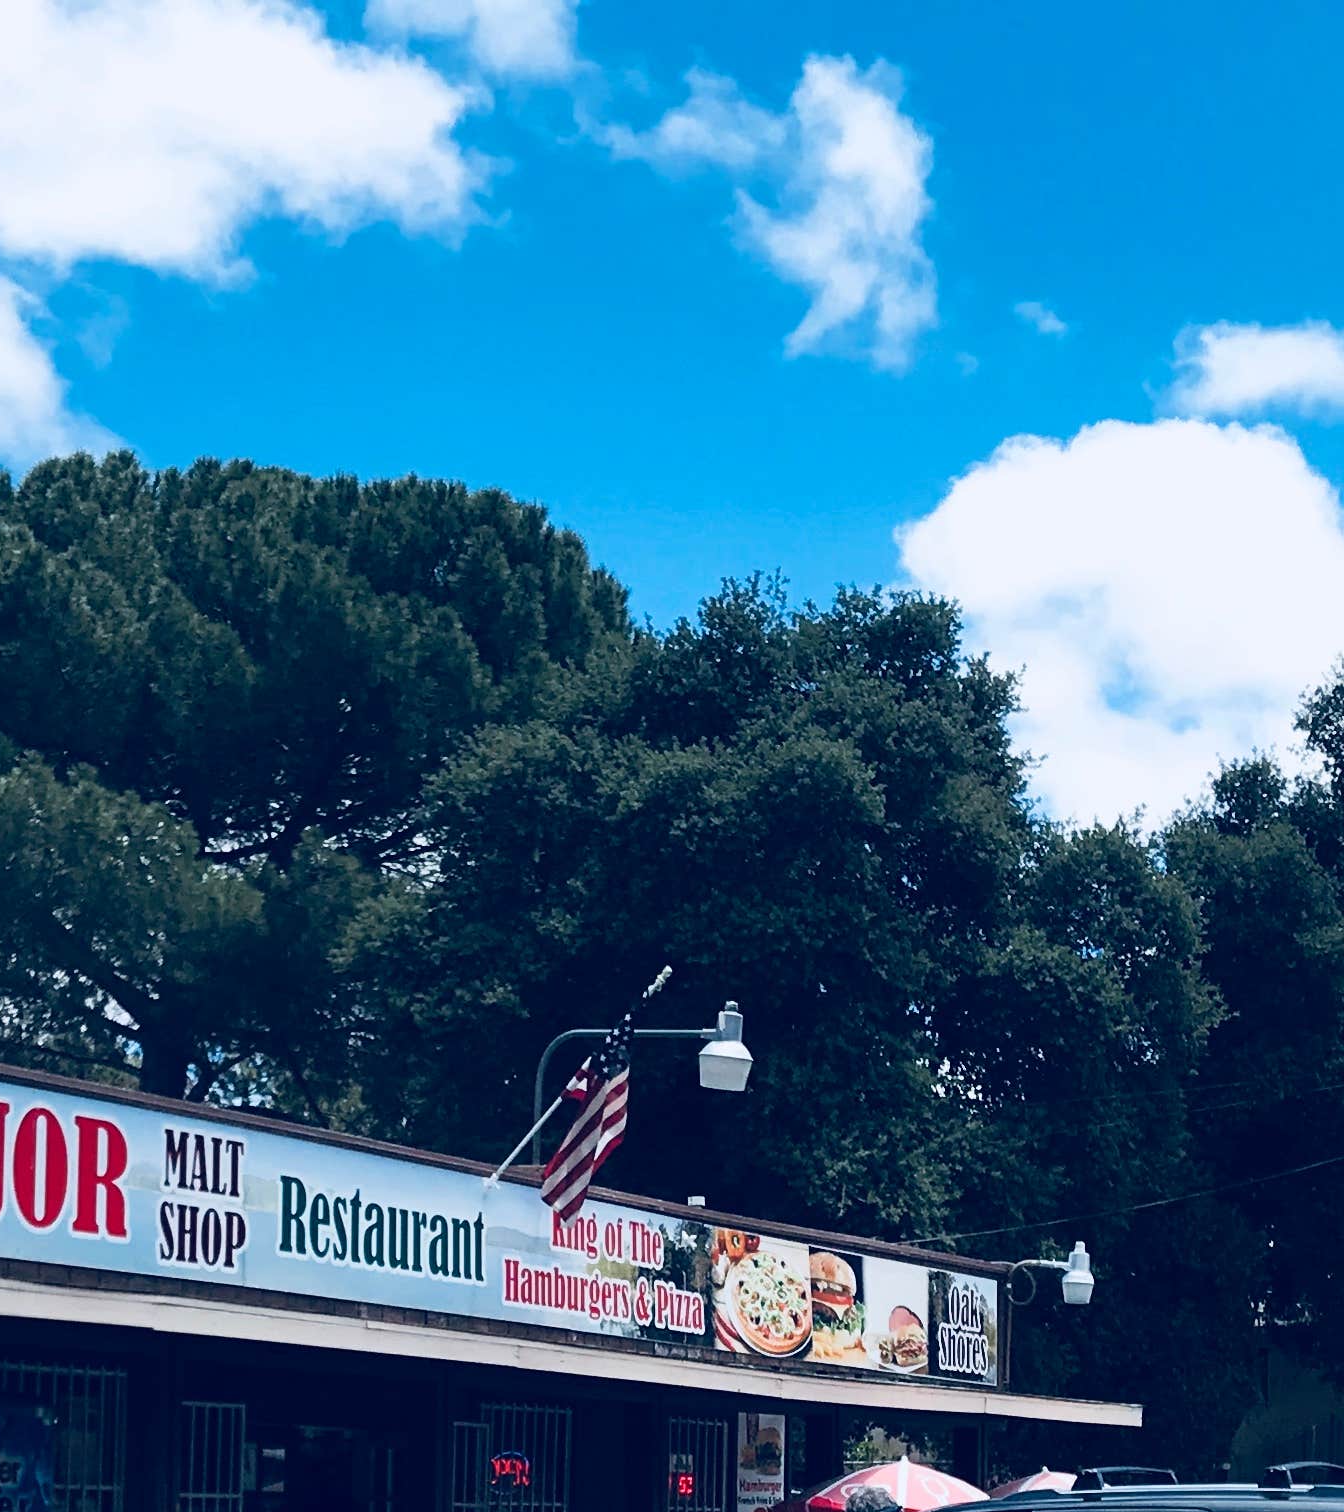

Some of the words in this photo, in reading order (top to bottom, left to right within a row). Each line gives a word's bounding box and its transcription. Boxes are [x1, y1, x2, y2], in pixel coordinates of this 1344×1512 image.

[163, 1128, 244, 1197] MALT
[159, 1201, 246, 1268] SHOP
[279, 1175, 484, 1281] Restaurant
[605, 1218, 623, 1258] of
[629, 1220, 664, 1265] The
[504, 1259, 629, 1320] Hamburgers
[635, 1281, 650, 1321] &
[656, 1283, 703, 1330] Pizza
[950, 1286, 979, 1329] Oak
[940, 1325, 988, 1371] Shores
